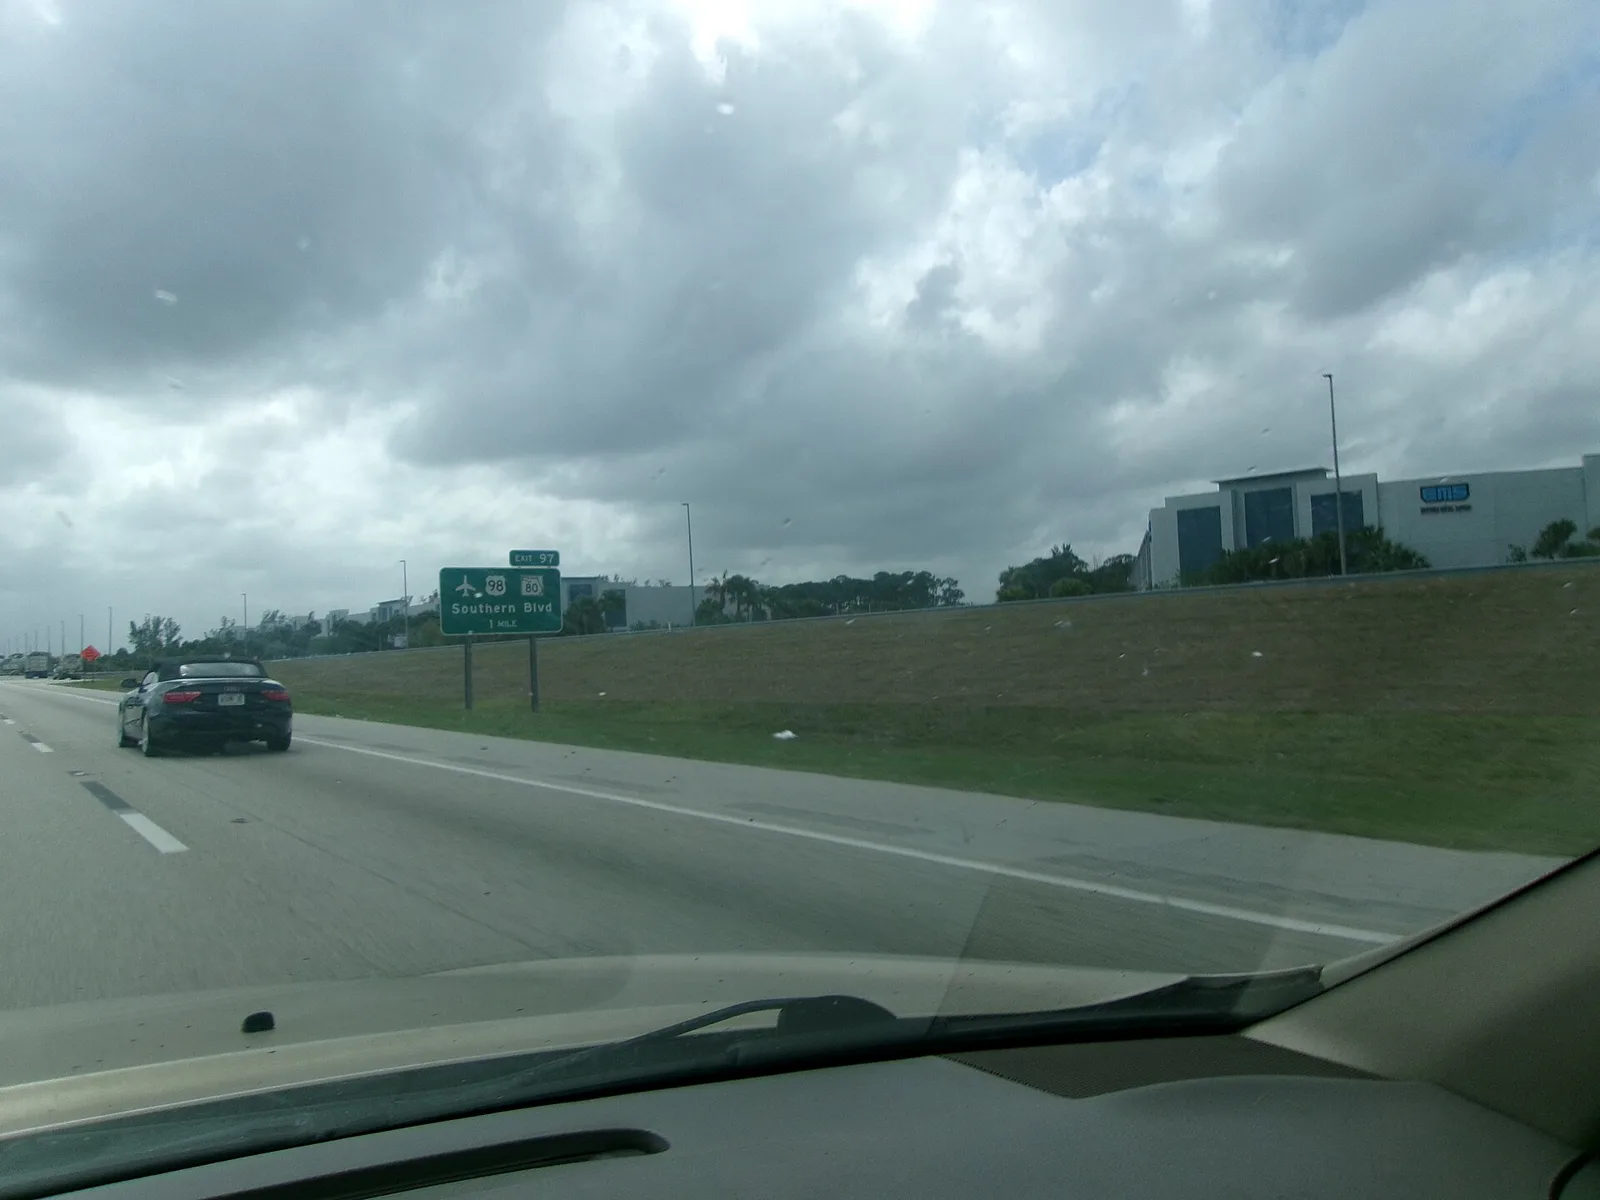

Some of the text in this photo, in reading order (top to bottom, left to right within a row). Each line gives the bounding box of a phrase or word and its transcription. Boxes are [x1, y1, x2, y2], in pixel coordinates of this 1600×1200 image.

[515, 553, 555, 564] EXIT 97
[488, 580, 539, 593] 98 80
[451, 602, 552, 614] Southern Blvd
[497, 620, 518, 628] MILE
